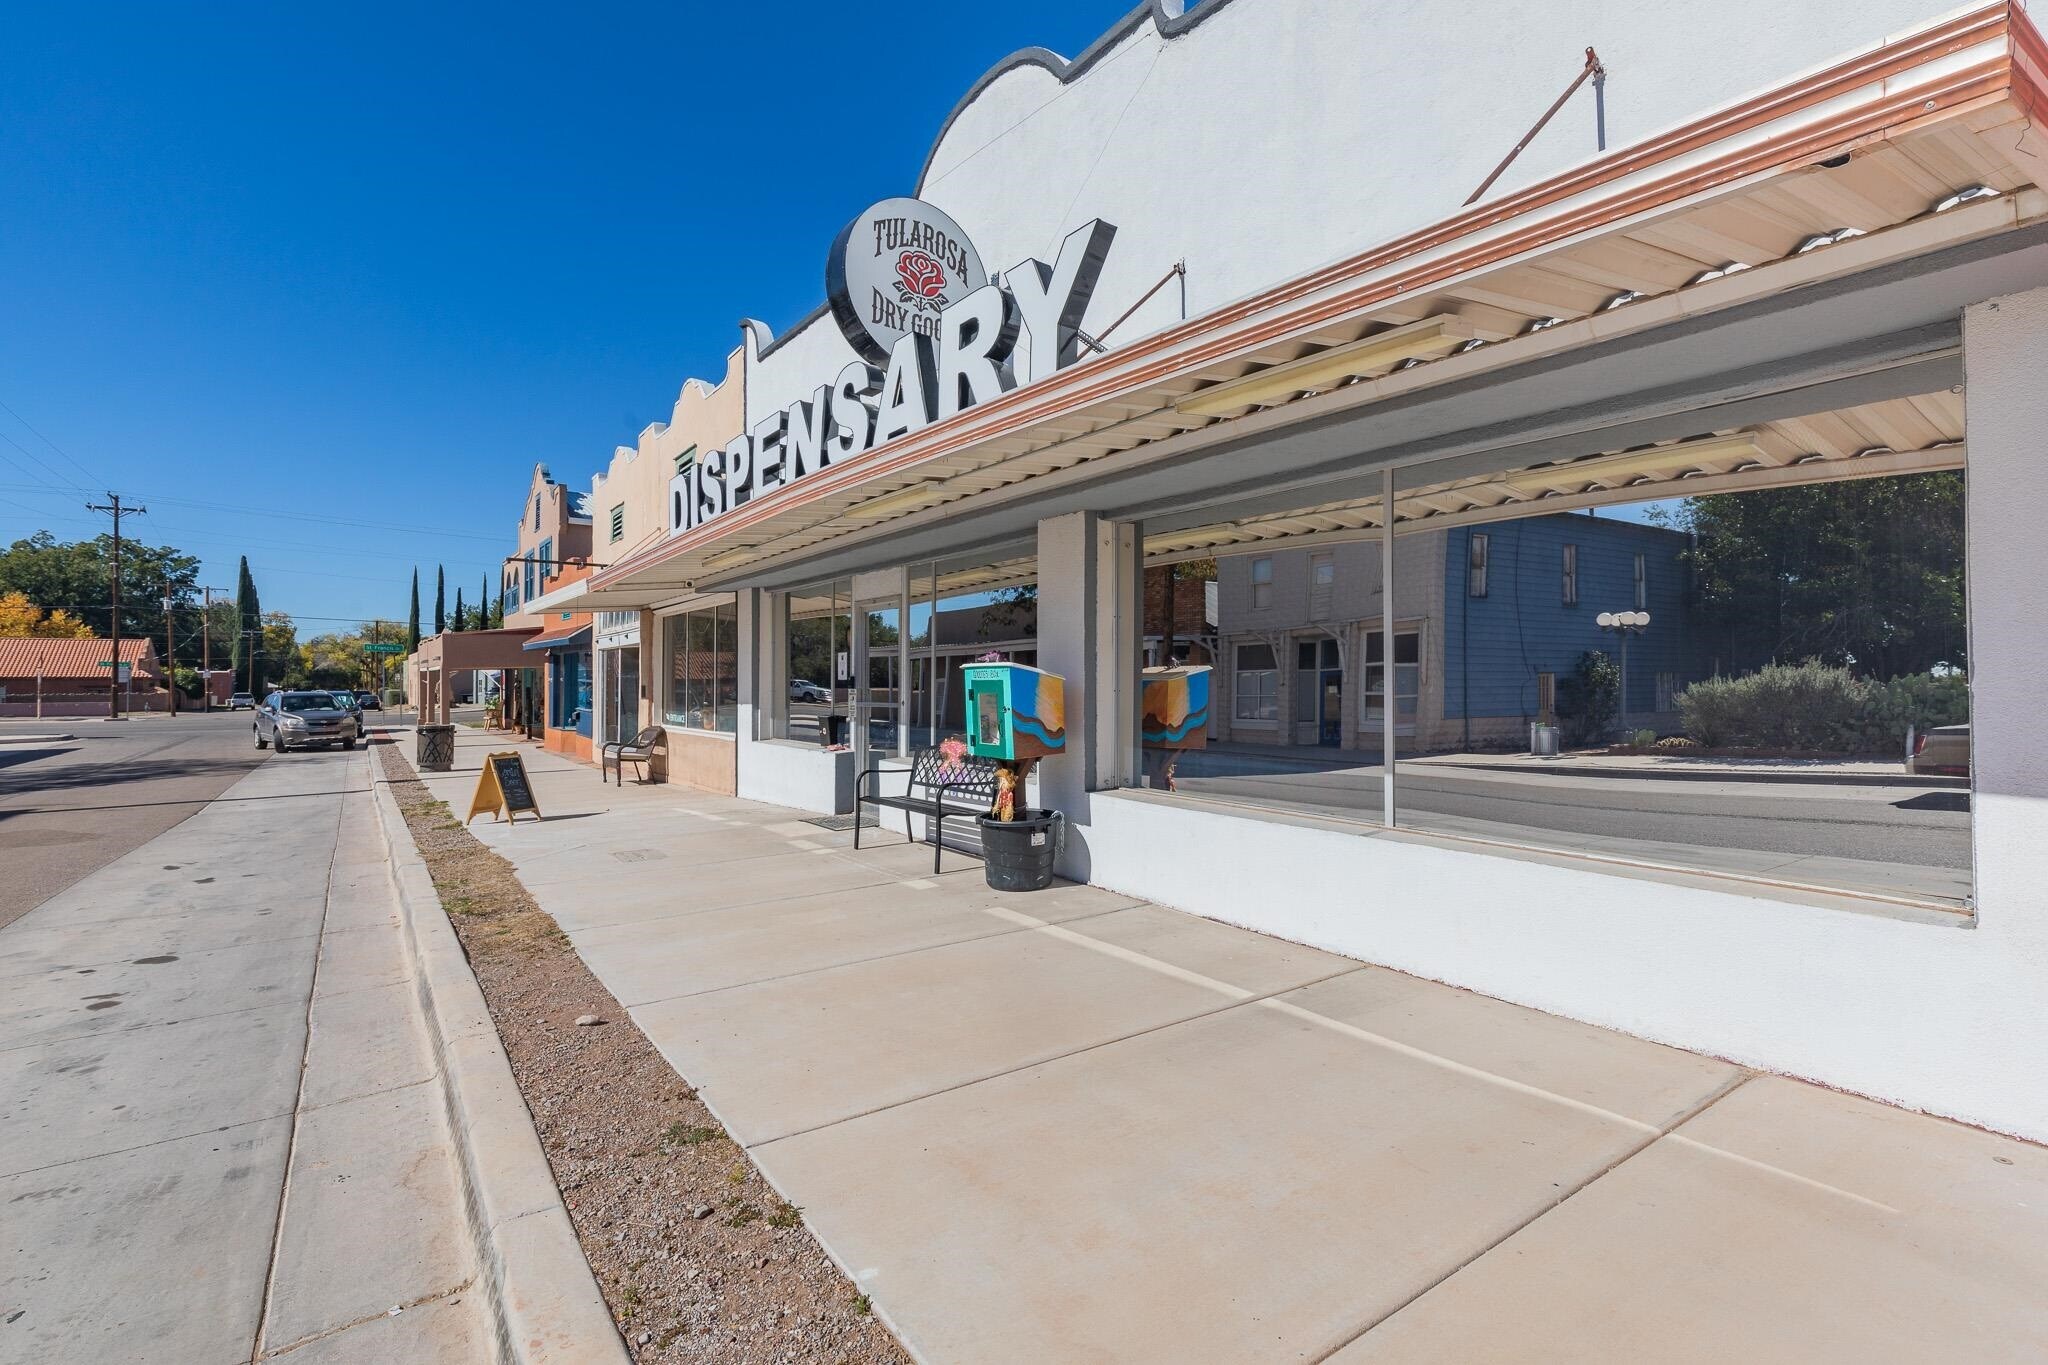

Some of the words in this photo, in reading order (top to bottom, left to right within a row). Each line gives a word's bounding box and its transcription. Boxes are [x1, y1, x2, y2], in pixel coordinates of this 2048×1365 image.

[873, 218, 968, 289] TULAROSA
[872, 285, 909, 332] DRY
[669, 218, 1112, 538] DISPENSARY
